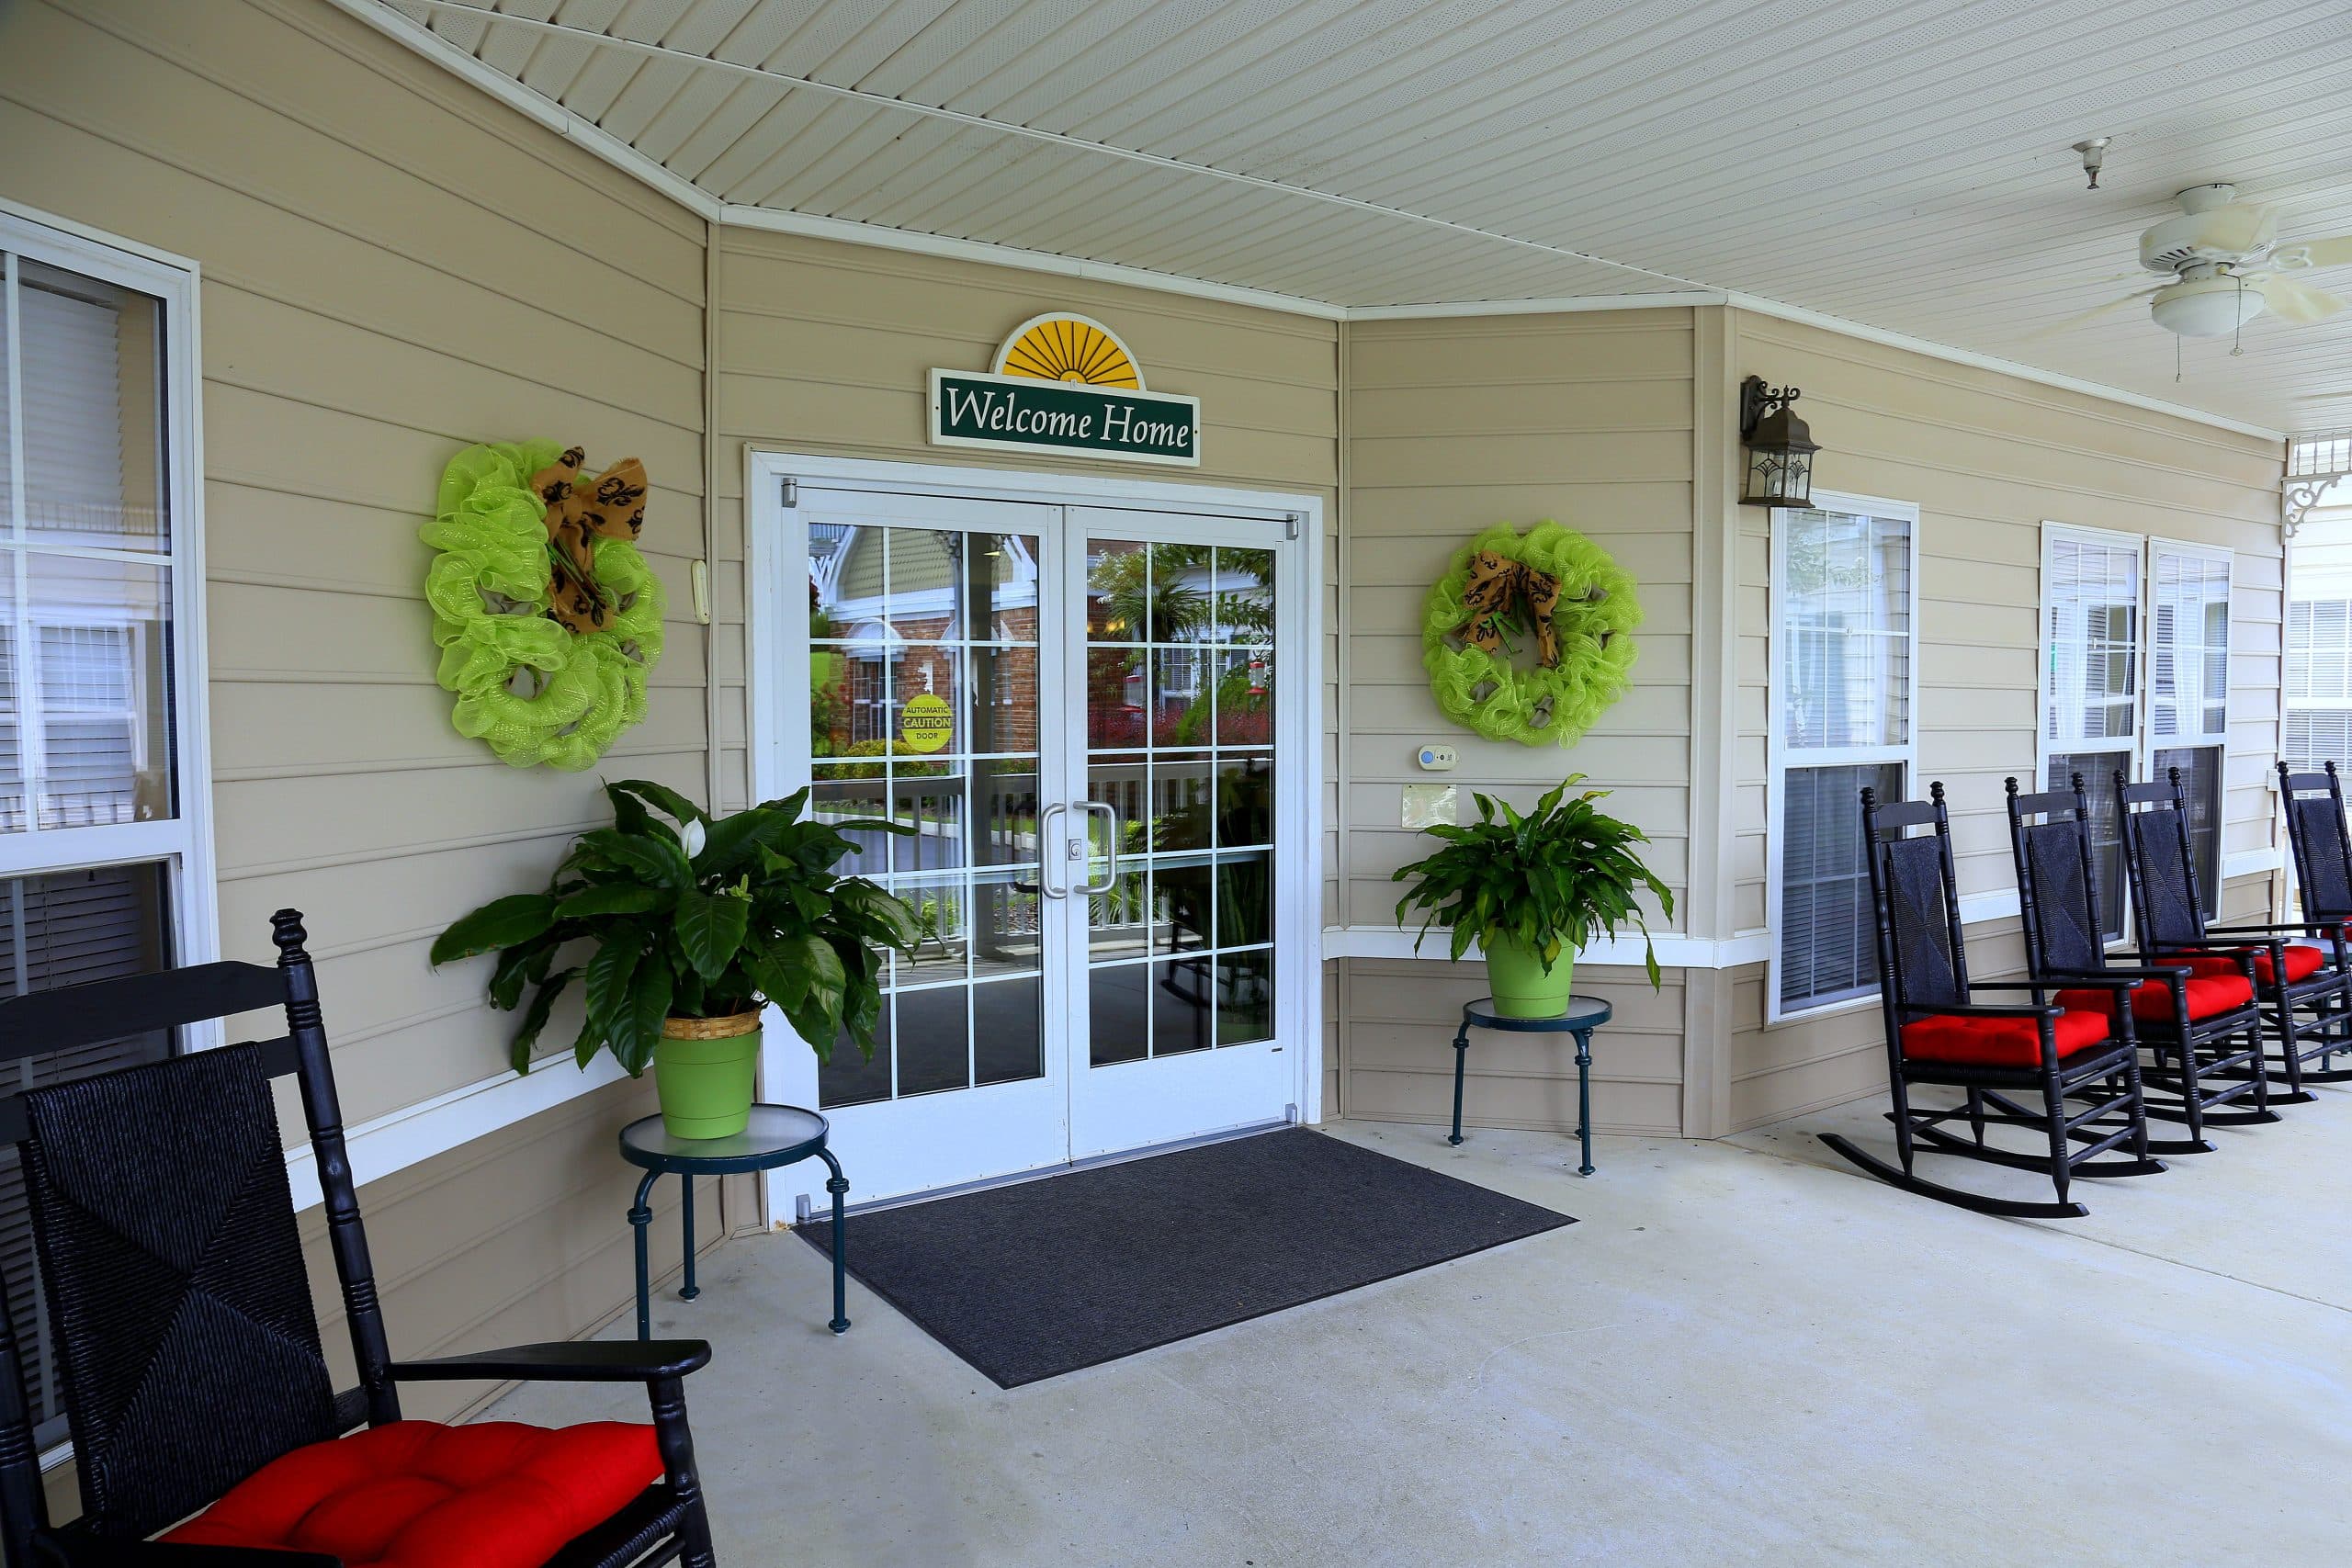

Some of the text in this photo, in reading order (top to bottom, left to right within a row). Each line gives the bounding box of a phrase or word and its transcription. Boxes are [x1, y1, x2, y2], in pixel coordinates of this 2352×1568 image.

[946, 387, 1189, 447] Welcome Home
[903, 717, 951, 728] CAUTION
